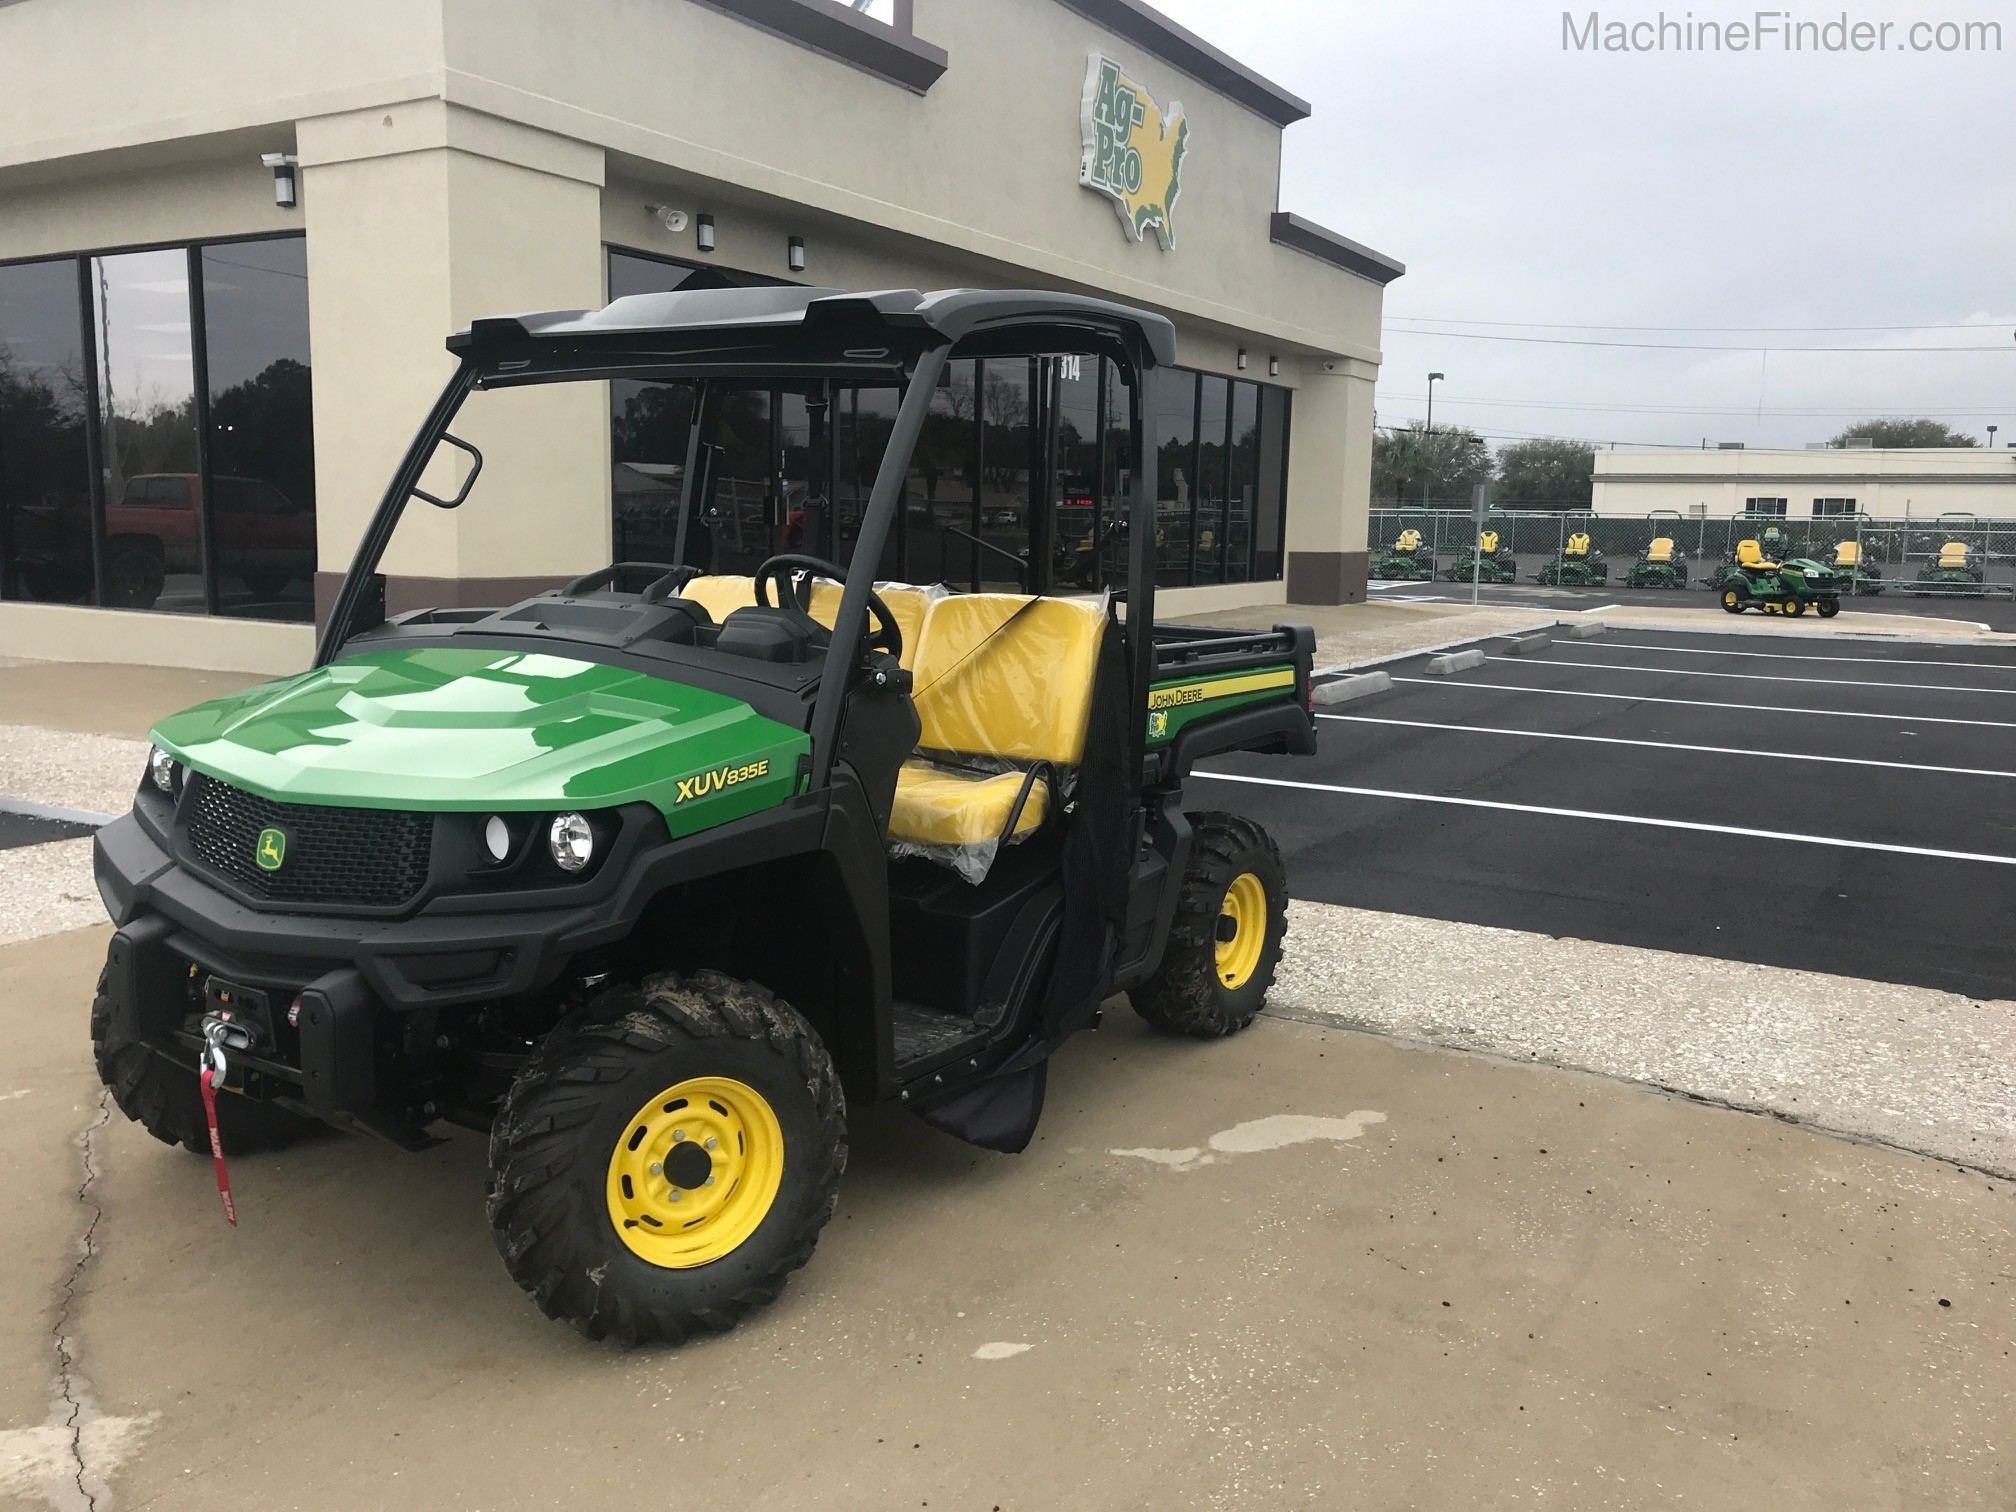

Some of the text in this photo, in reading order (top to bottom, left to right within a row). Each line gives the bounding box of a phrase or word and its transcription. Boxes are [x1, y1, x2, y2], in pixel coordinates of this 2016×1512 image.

[1094, 59, 1144, 146] Ag-
[1091, 122, 1143, 194] Pro
[1150, 688, 1203, 709] JOHN DEERE
[674, 758, 770, 805] XUV835E
